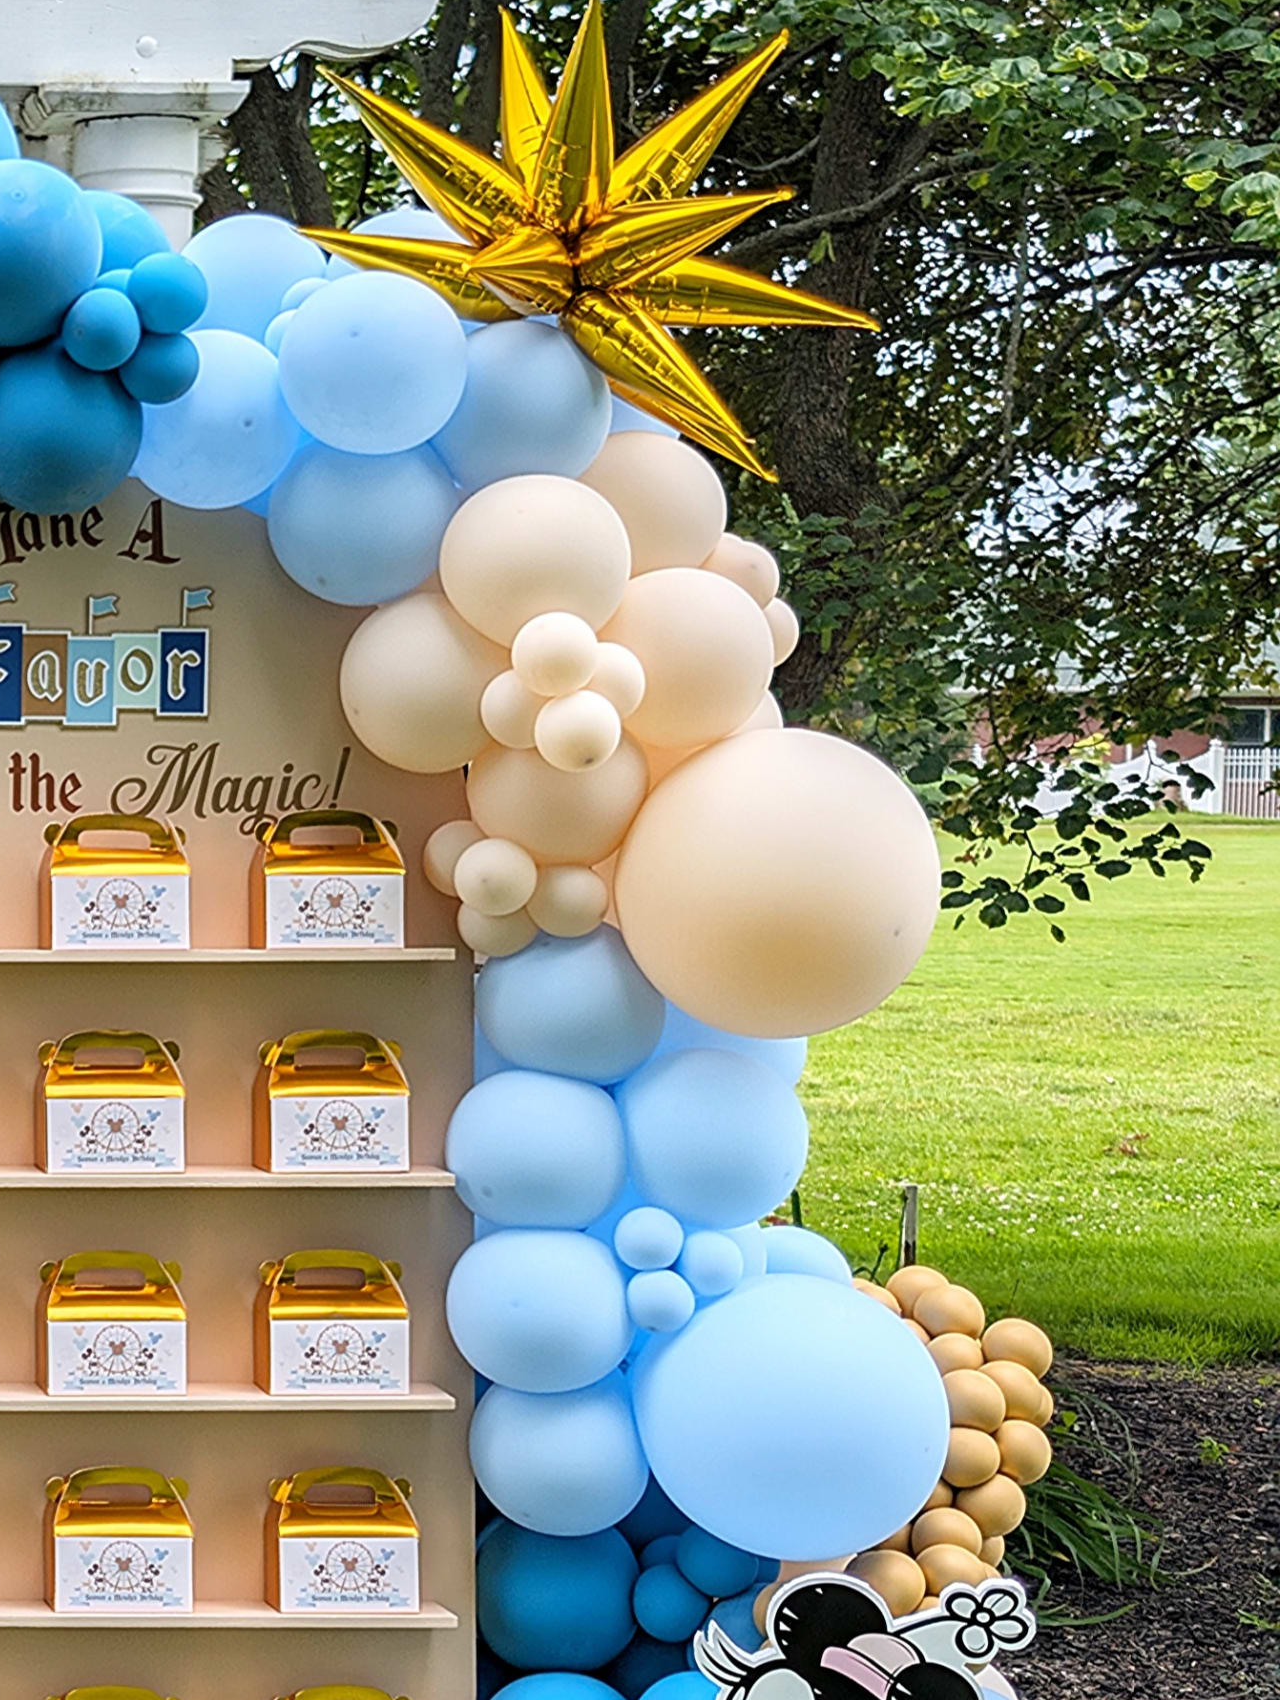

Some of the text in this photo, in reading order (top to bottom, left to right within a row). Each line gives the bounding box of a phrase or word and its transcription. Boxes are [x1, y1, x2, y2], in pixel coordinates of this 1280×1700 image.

[117, 499, 181, 564] A
[8, 752, 83, 813] the
[110, 742, 351, 836] Magic!
